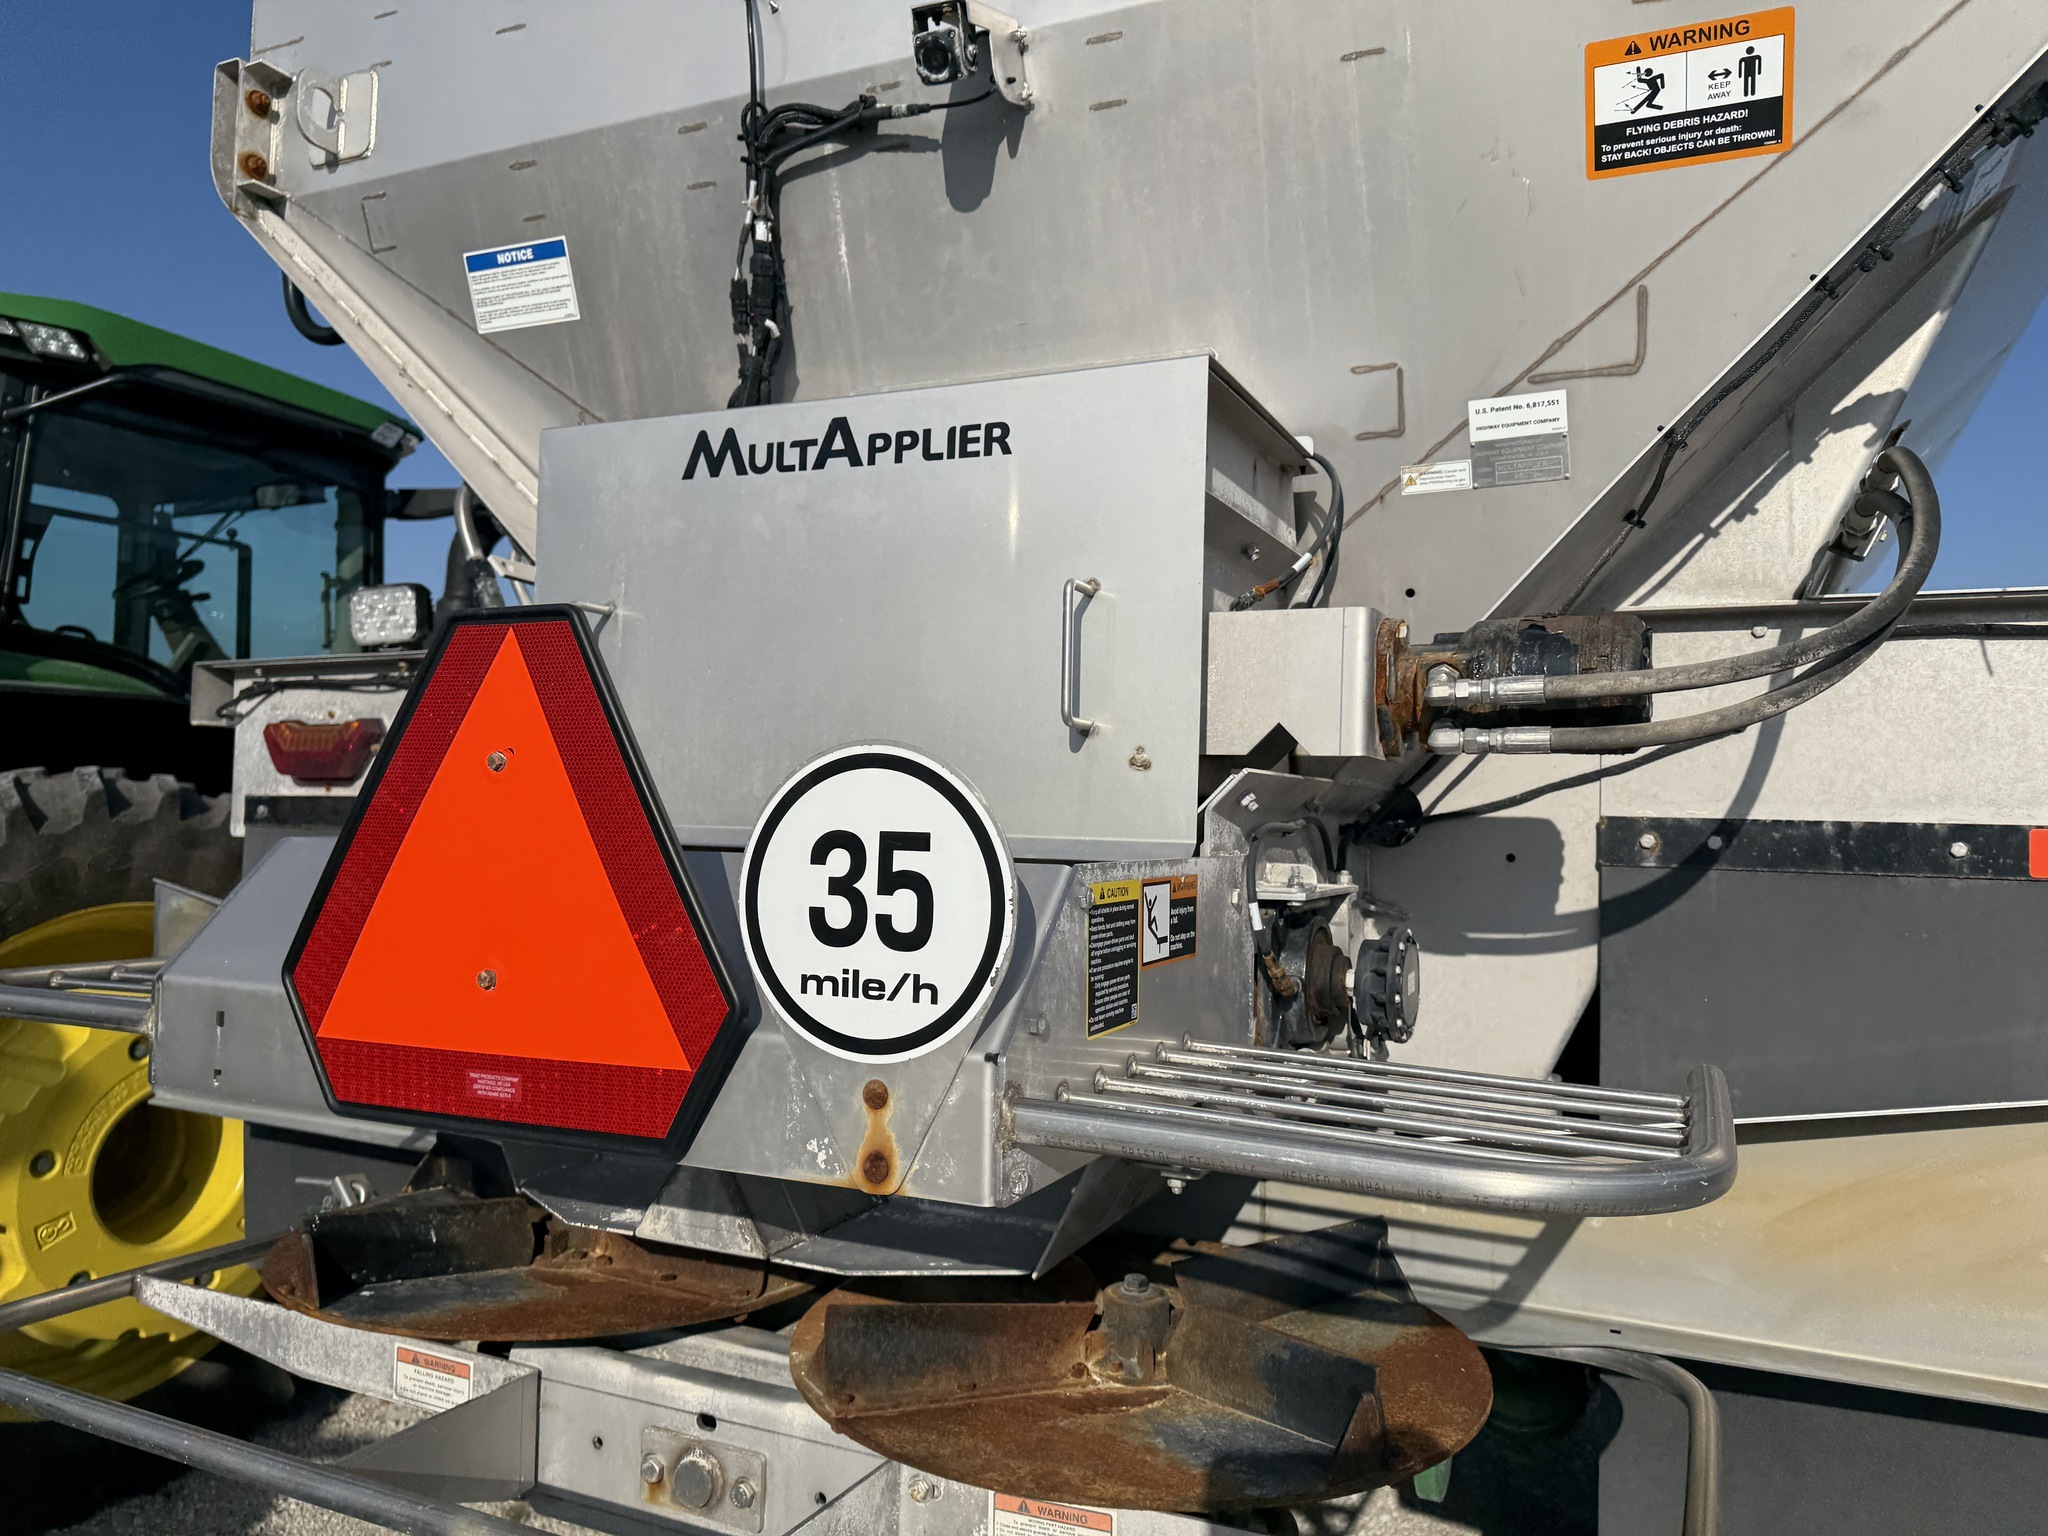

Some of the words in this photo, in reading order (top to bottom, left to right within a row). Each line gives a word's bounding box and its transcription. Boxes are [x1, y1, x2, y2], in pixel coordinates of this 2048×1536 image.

[1649, 19, 1750, 51] WARNING
[1708, 81, 1731, 91] KEEP
[1707, 90, 1732, 100] AWAY
[1626, 123, 1661, 136] FLYING
[1664, 116, 1700, 131] DEBRIS
[1703, 109, 1749, 124] HAZARD!
[1601, 144, 1611, 152] To
[1614, 139, 1644, 152] prevent
[1646, 134, 1676, 145] serious
[1679, 130, 1701, 142] injury
[1716, 123, 1742, 135] death:
[1601, 153, 1622, 163] STAY
[1625, 148, 1651, 159] BACK!
[1654, 142, 1694, 155] OBJECTS
[1697, 138, 1715, 148] CAN
[1718, 136, 1730, 145] BE
[1733, 129, 1775, 143] THROWN!
[497, 248, 534, 264] NOTICE
[1475, 407, 1489, 415] U.S.
[1490, 404, 1512, 413] Patent
[1526, 399, 1560, 410] 6,817,551
[1501, 420, 1532, 428] EQUIPMENT
[808, 829, 935, 952] 35
[1107, 886, 1129, 899] CAUTION
[1171, 907, 1179, 916] Avoid
[1179, 904, 1187, 916] injury
[1170, 934, 1175, 943] Do
[1187, 931, 1191, 939] on
[1170, 941, 1183, 952] machine.
[800, 968, 939, 1005] mile/h
[424, 1358, 456, 1373] WARNING
[414, 1368, 434, 1379] FALLING
[435, 1374, 455, 1384] HAZARD
[1038, 1506, 1088, 1525] WARNING
